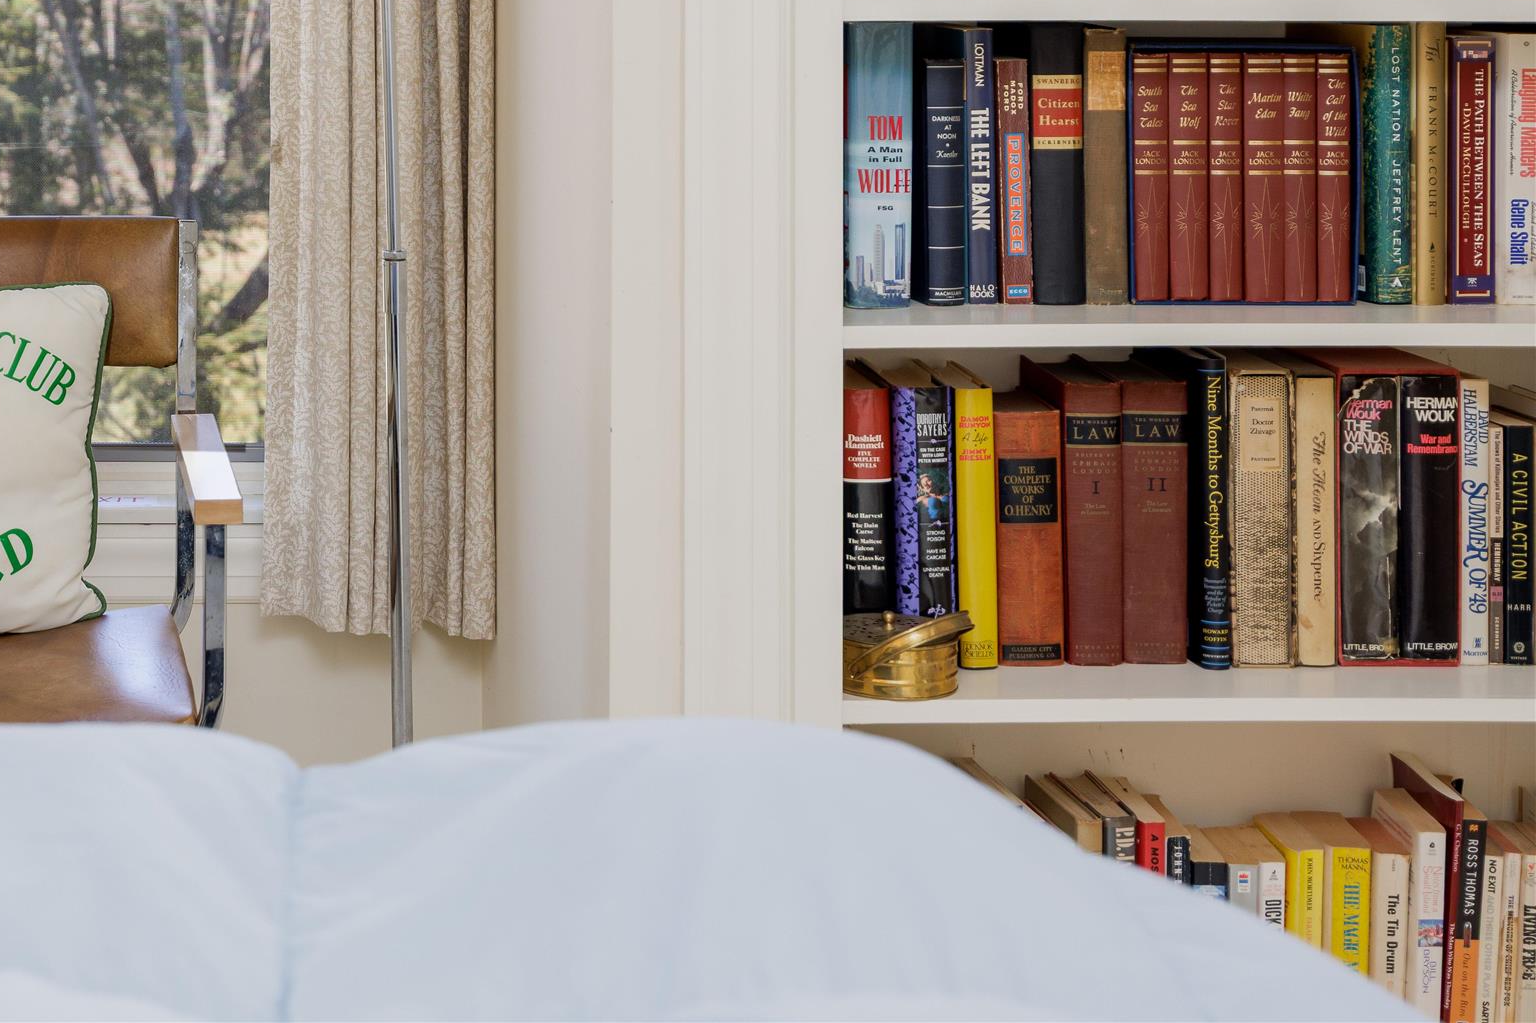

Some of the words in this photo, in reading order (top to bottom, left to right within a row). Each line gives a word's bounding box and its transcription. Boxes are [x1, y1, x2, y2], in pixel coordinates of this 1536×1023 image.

[1391, 47, 1400, 81] LOST
[1474, 69, 1485, 96] THE
[1038, 98, 1080, 108] Citizen
[1392, 89, 1400, 143] NATION
[1474, 99, 1485, 133] PATH
[868, 116, 903, 141] TOM
[970, 108, 989, 137] THE
[1039, 115, 1079, 126] Hearst
[970, 143, 989, 177] LEFT
[1474, 136, 1485, 199] BETWEEN
[858, 168, 911, 193] WOLFE
[1393, 160, 1401, 222] JEFFREY
[972, 183, 990, 230] BANK
[1009, 139, 1023, 251] PROVENCE
[1474, 202, 1484, 229] THE
[1393, 230, 1402, 264] LENT
[1474, 233, 1484, 267] SEAS
[1207, 376, 1221, 410] Nine
[1344, 420, 1372, 431] THE
[1416, 410, 1454, 422] WOUK
[848, 434, 881, 442] Dashiell
[917, 424, 947, 436] SAYERS
[1073, 427, 1116, 439] LAW
[1135, 425, 1179, 437] LAW
[1208, 416, 1222, 470] Months
[1344, 432, 1388, 442] WINDS
[1344, 443, 1360, 454] OF
[1361, 443, 1391, 454] WAR
[1511, 454, 1523, 462] A
[1004, 475, 1051, 484] COMPLETE
[1018, 466, 1035, 474] THE
[1209, 475, 1218, 487] to
[1012, 485, 1044, 494] WORKS
[1022, 495, 1034, 504] OF
[1312, 468, 1325, 513] Moon
[1511, 470, 1527, 514] CIVIL
[1204, 491, 1222, 568] Gettysburg
[1462, 480, 1488, 567] SUMMER
[1511, 522, 1527, 580] ACTION
[1309, 542, 1326, 603] Sixpence
[1468, 568, 1485, 589] OF
[1469, 593, 1487, 614] '49
[1467, 839, 1479, 868] ROSS
[1344, 883, 1360, 909] THE
[1387, 894, 1399, 914] The
[1464, 872, 1476, 915] THOMAS
[1343, 914, 1360, 955] MAGIC
[1386, 920, 1399, 936] Tin
[1385, 941, 1399, 973] Drum
